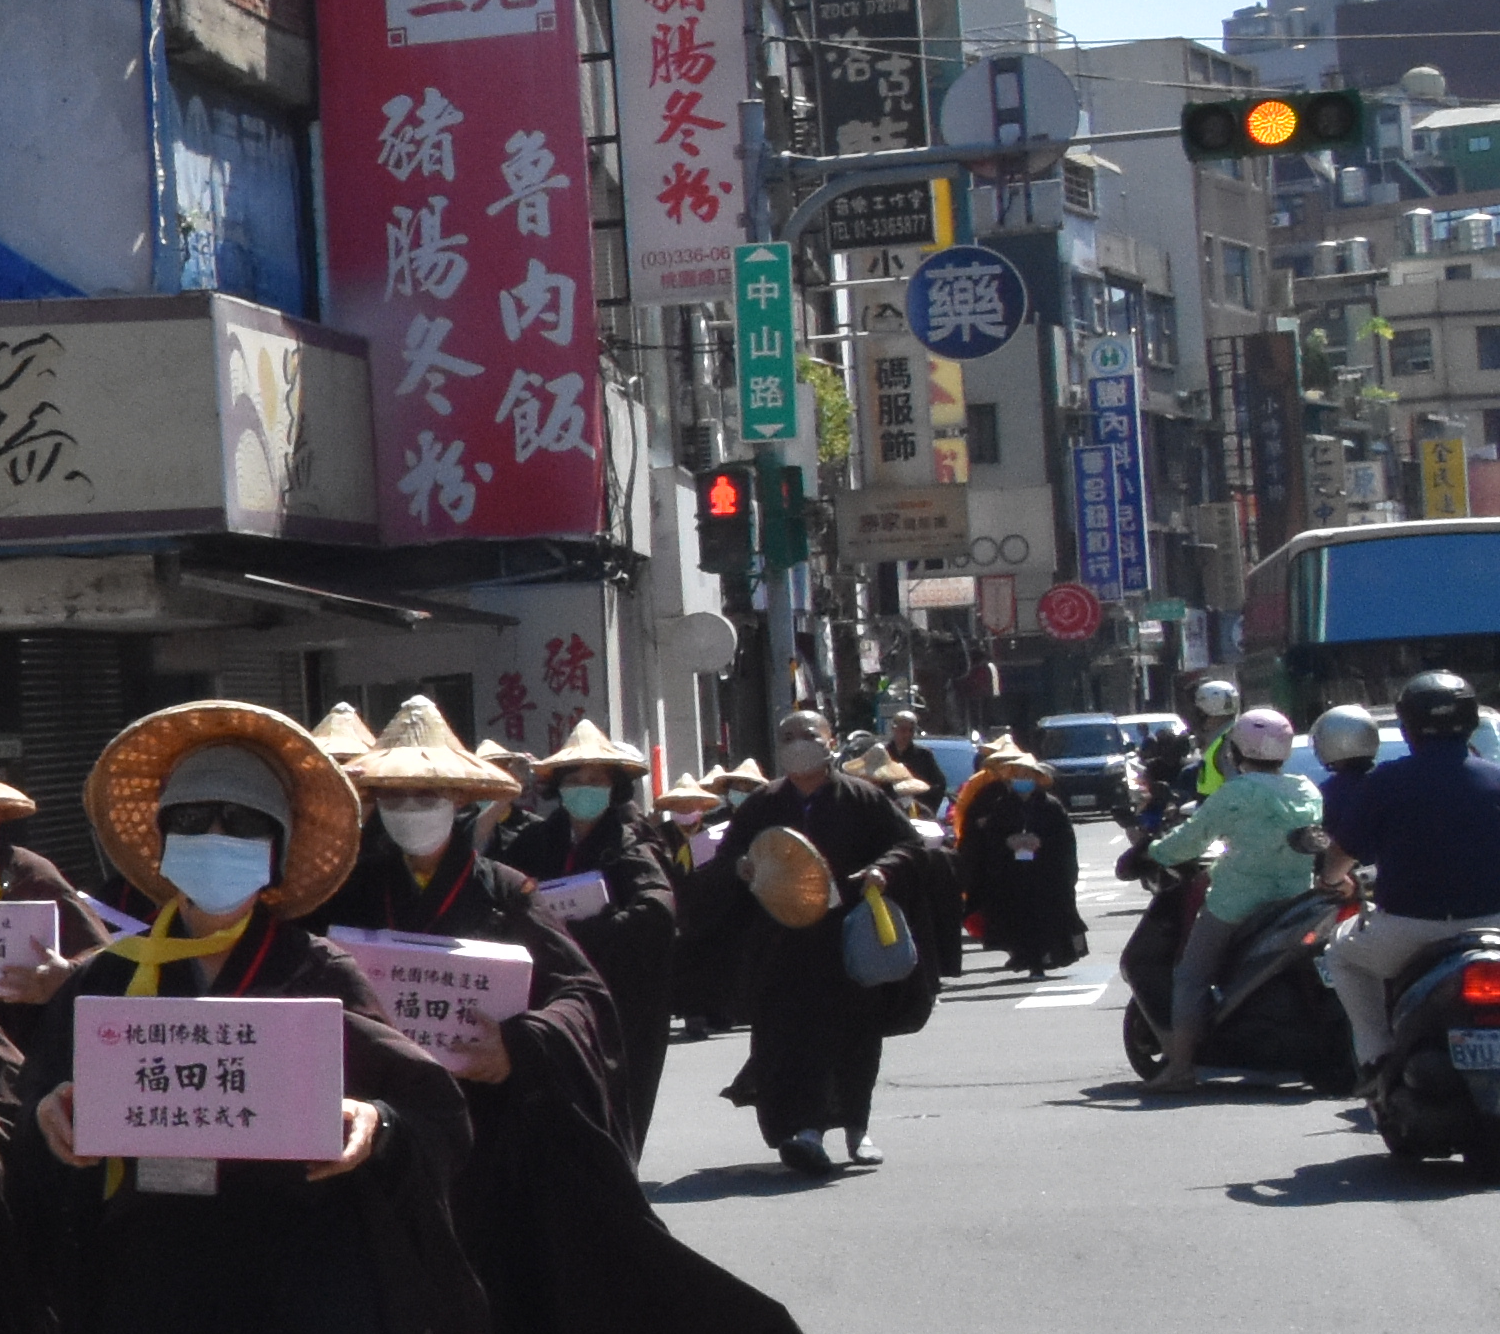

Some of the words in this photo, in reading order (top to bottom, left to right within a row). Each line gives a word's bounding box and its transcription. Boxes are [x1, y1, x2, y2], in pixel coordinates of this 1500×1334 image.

[378, 88, 492, 527] 豬腸冬粉
[487, 129, 596, 463] 魯肉飯
[925, 262, 1007, 343] 藥
[746, 275, 785, 410] 中山路
[125, 1023, 257, 1046] 桃園佛教蓮社
[135, 1057, 247, 1094] 福田箱
[125, 1106, 257, 1129] 短期出家戒會
